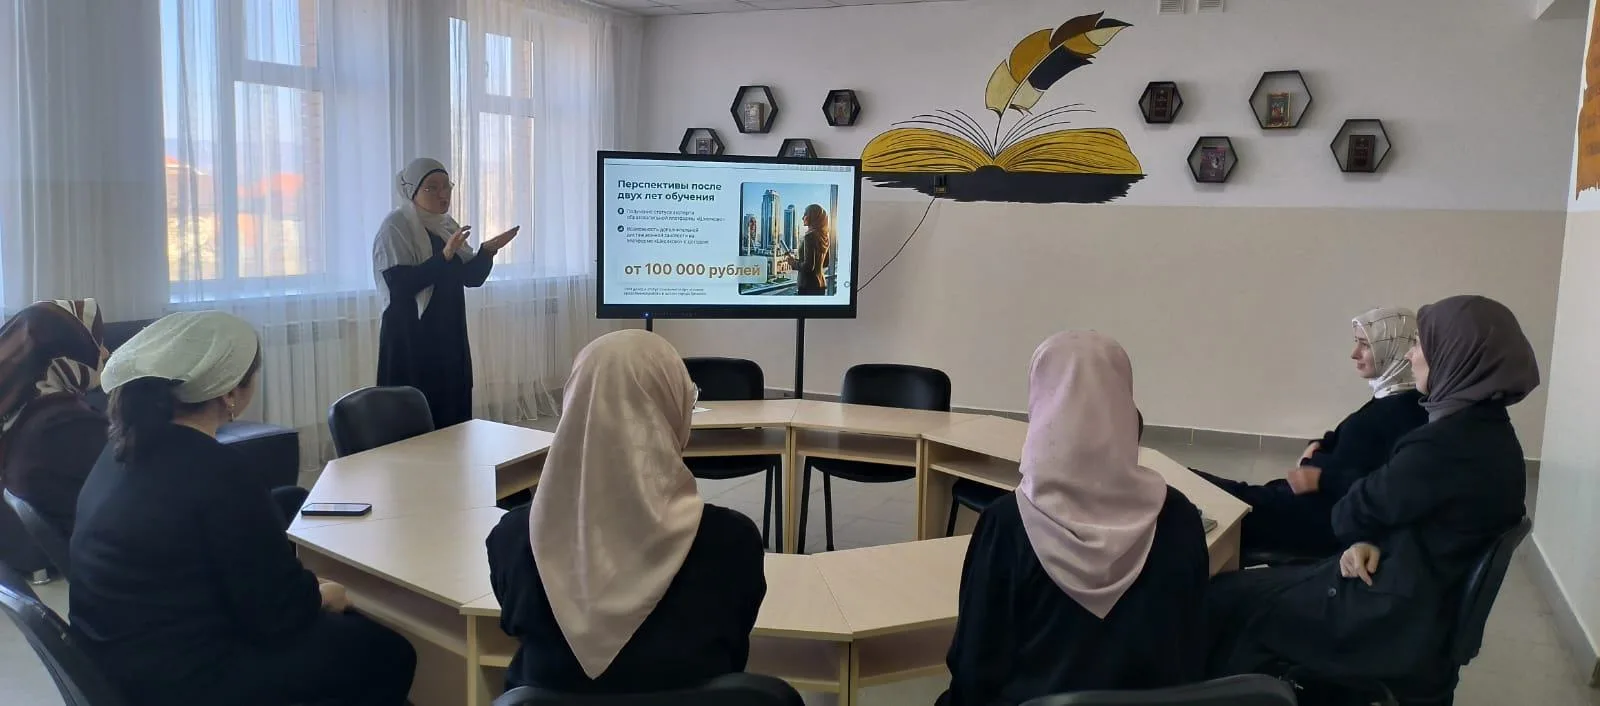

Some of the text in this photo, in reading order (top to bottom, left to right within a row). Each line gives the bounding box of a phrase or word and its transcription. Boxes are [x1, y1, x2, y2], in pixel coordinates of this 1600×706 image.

[618, 180, 722, 191] Перспективы после
[617, 192, 642, 201] двух
[665, 191, 715, 202] обучения
[624, 263, 761, 279] от 100 000 рублей
